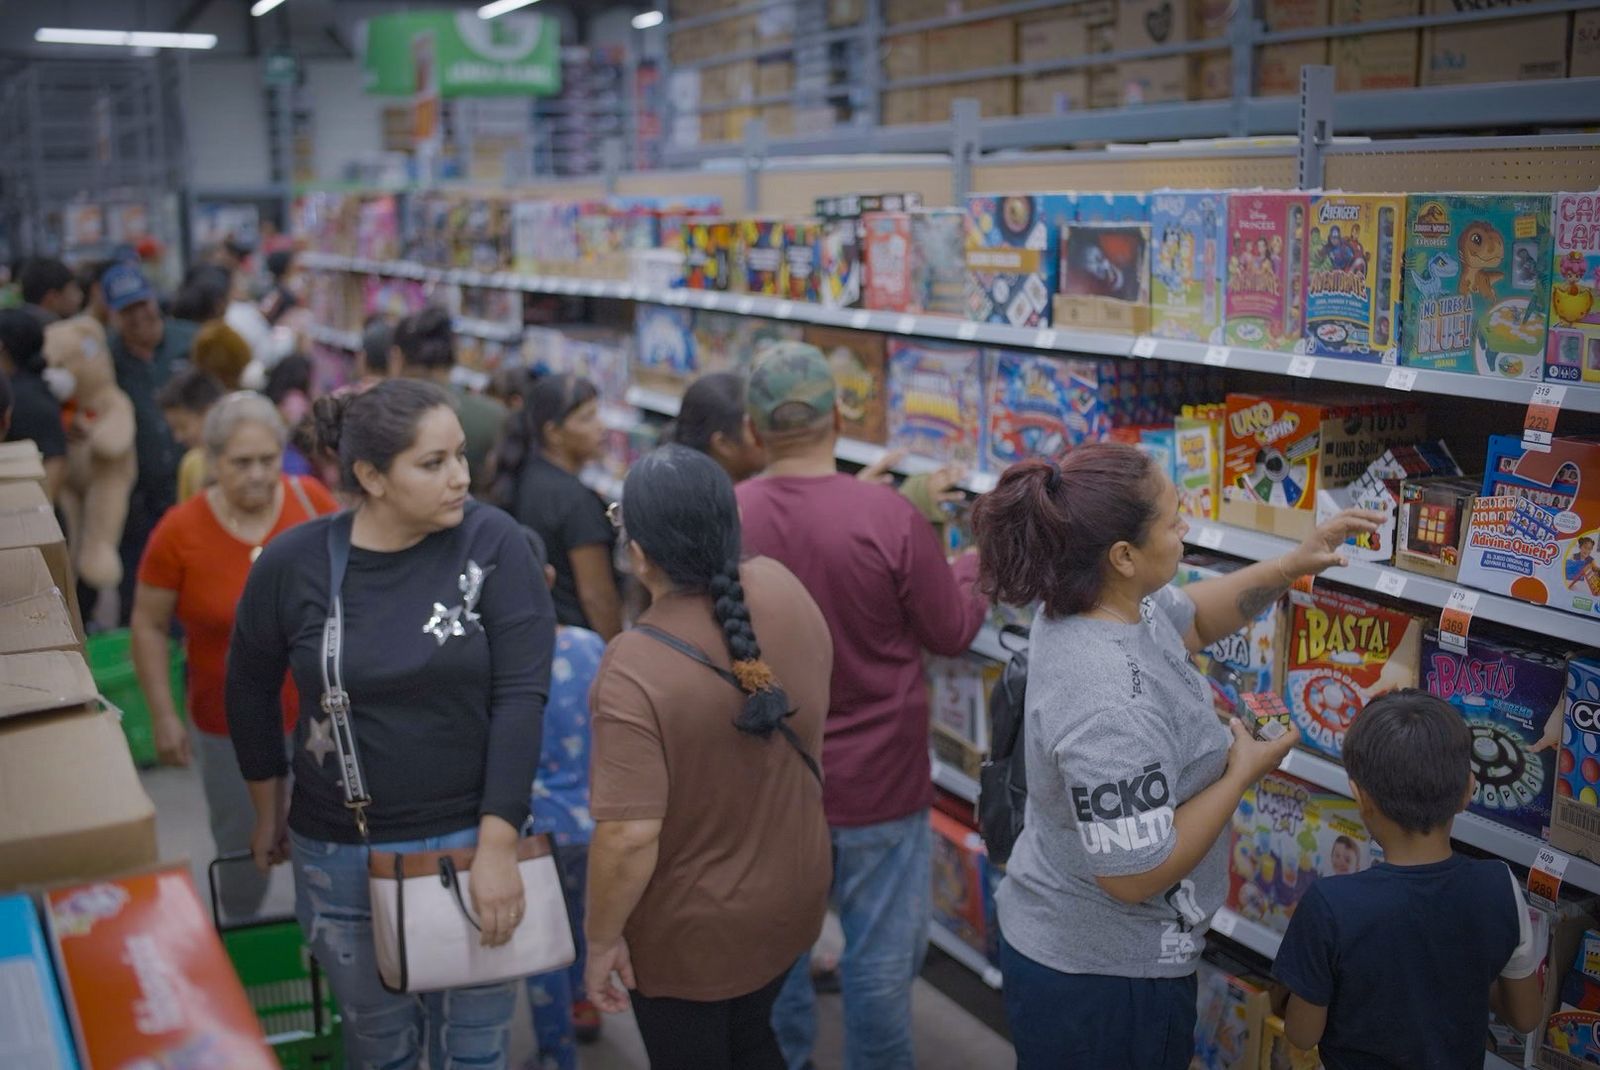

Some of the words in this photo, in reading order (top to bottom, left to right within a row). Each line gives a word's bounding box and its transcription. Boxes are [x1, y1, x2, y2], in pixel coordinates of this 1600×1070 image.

[1440, 297, 1463, 316] TIRES
[1418, 313, 1472, 354] BLUE!
[1230, 402, 1274, 438] UNO
[1265, 420, 1295, 442] SPIN
[1297, 608, 1390, 665] ¡BASTA!
[1427, 654, 1515, 699] ¡BASTA!
